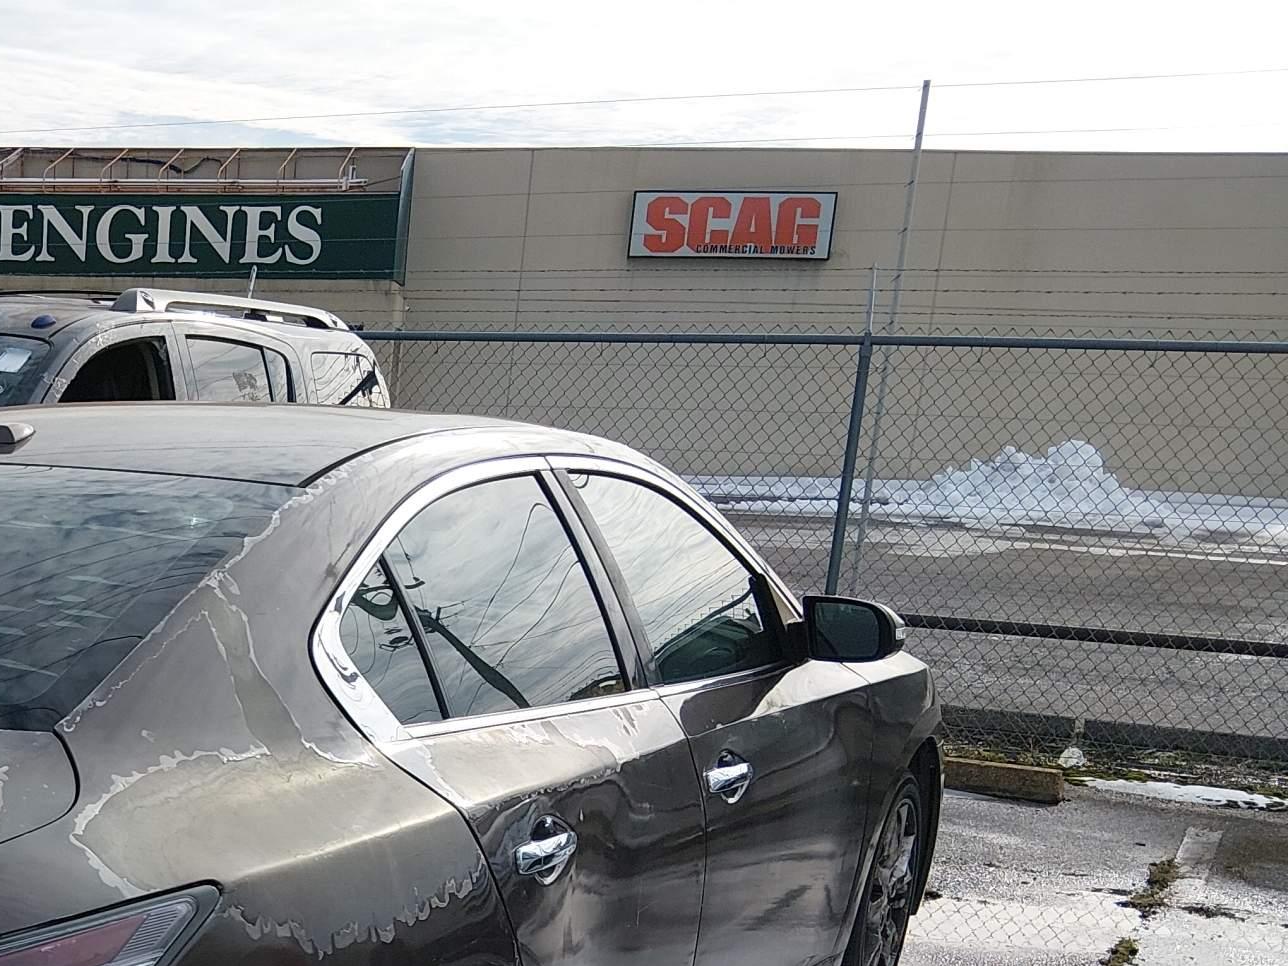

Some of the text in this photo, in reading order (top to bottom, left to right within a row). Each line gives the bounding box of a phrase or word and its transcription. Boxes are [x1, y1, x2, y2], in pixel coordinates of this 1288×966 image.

[643, 196, 822, 253] SCAG
[695, 243, 817, 255] COMMERCIAL MOWERS
